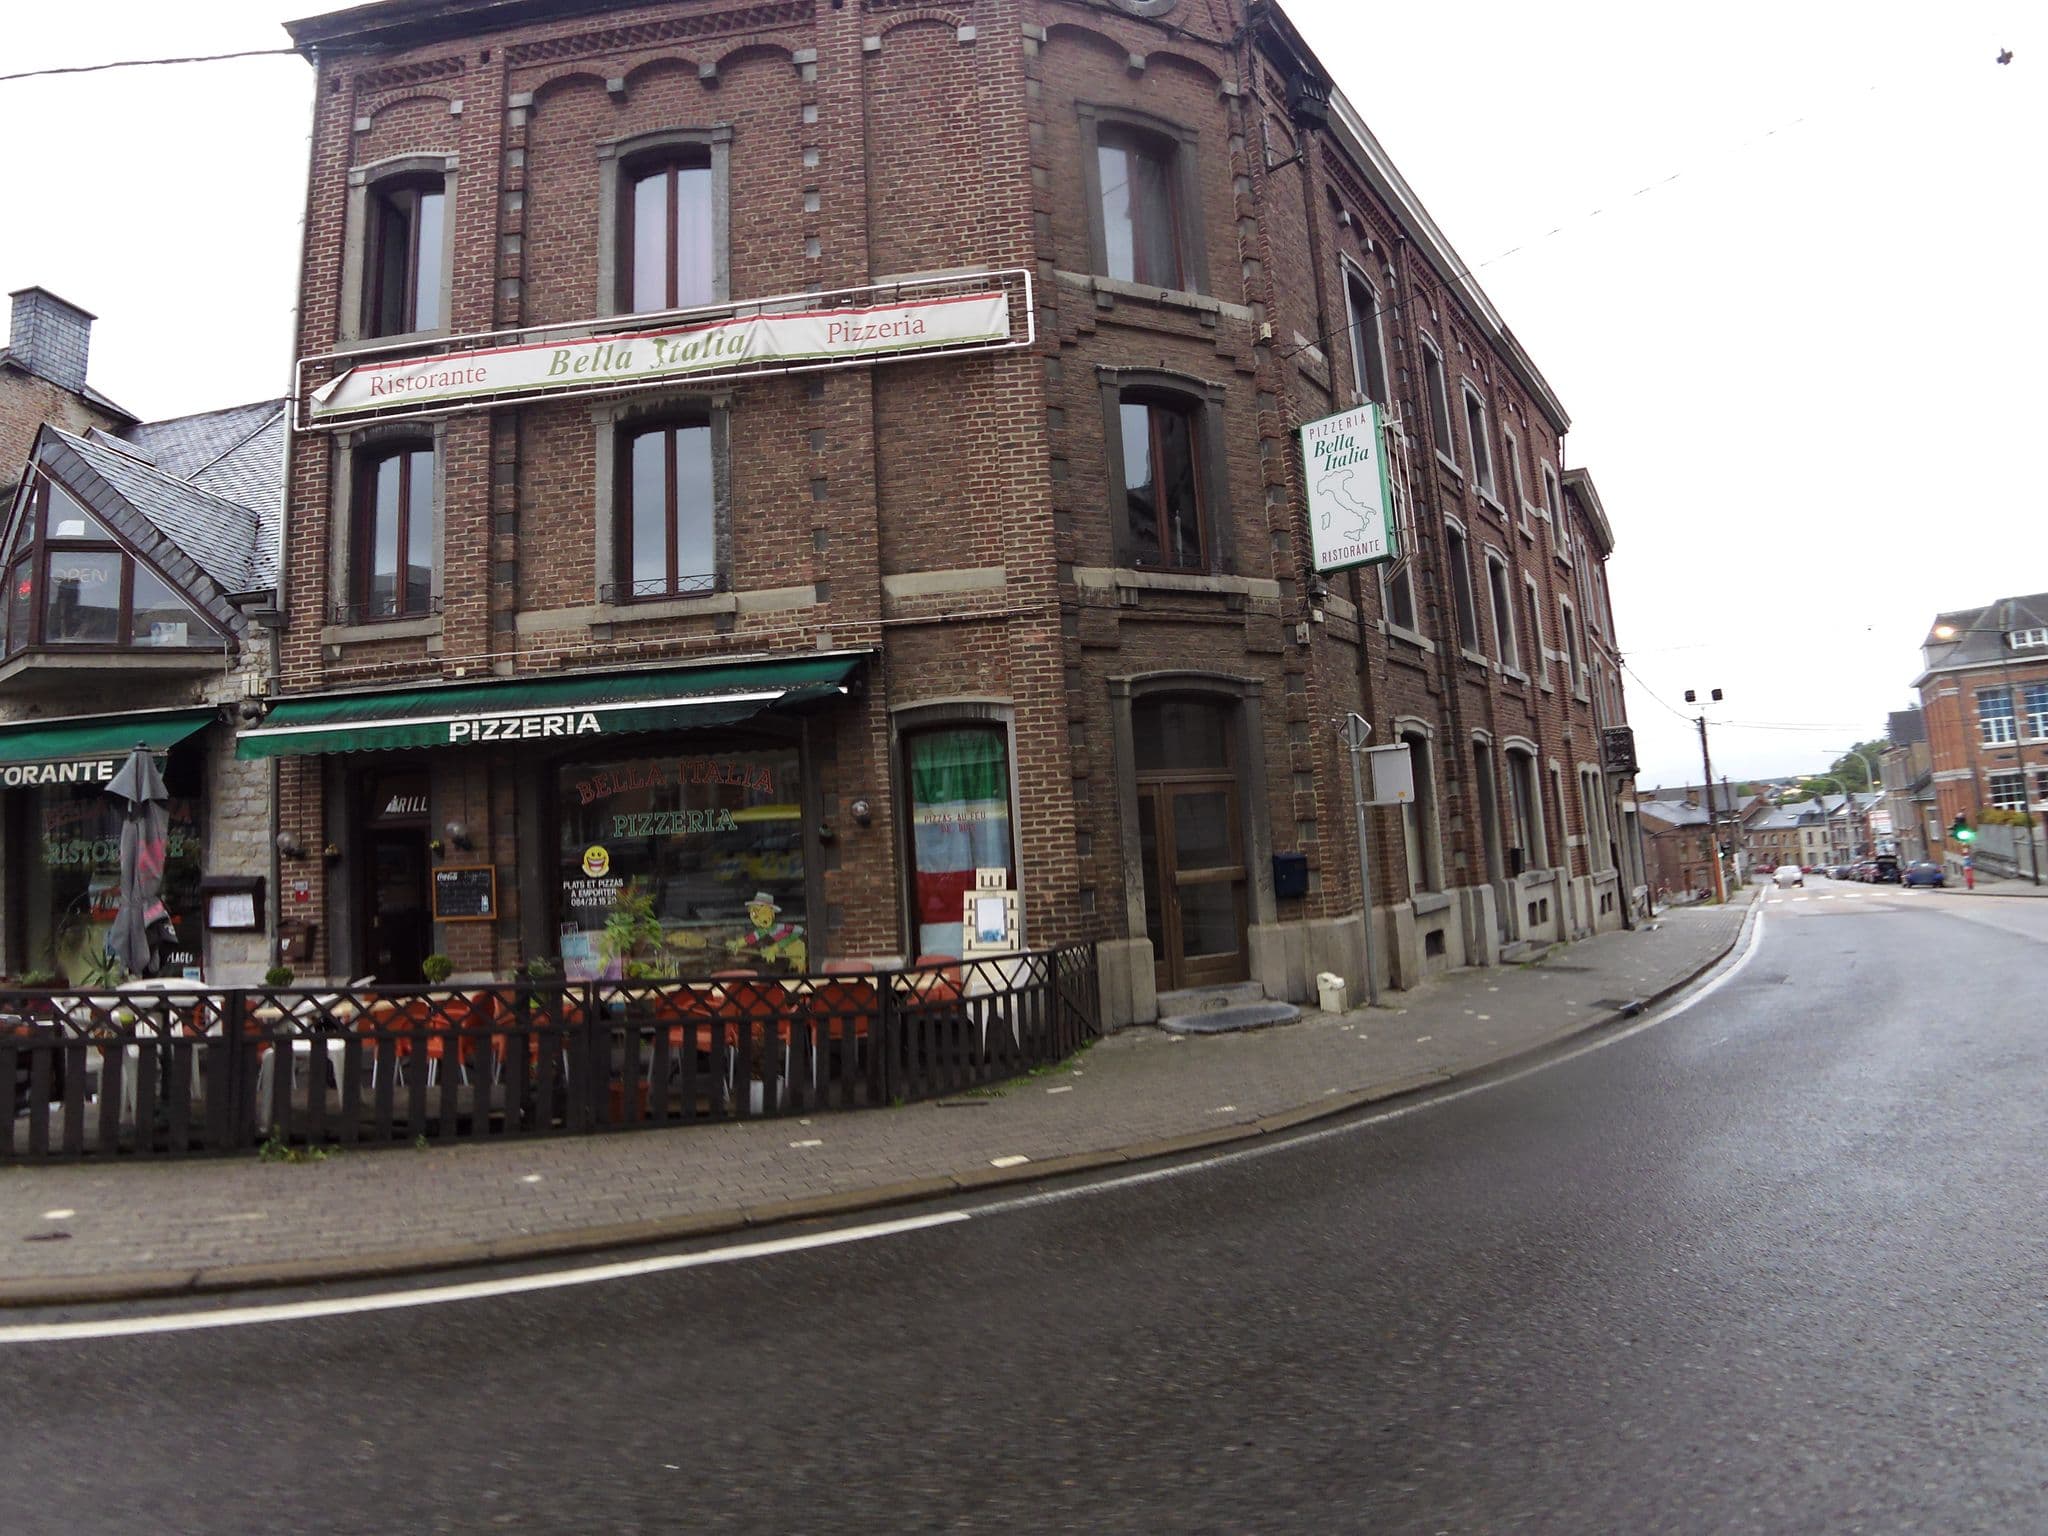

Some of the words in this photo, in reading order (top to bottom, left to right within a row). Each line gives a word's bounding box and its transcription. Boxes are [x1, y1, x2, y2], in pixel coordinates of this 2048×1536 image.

[369, 367, 488, 396] Ristorante
[547, 345, 634, 376] Bella
[650, 330, 746, 369] Italia
[827, 314, 926, 344] Pizzeria
[1309, 412, 1367, 440] PIZZERIA
[1314, 433, 1354, 458] Bella
[1324, 446, 1369, 472] Italia
[1321, 539, 1380, 564] RISTORANTE
[53, 568, 109, 584] OPEN
[449, 713, 602, 742] PIZZERIA
[576, 763, 667, 804] BELLA
[678, 759, 774, 794] ITALIA
[612, 808, 738, 838] PIZZERIA
[563, 880, 585, 890] PLATS
[586, 880, 596, 888] ET
[598, 878, 624, 888] PIZZAS
[578, 888, 617, 897] EMPORTER
